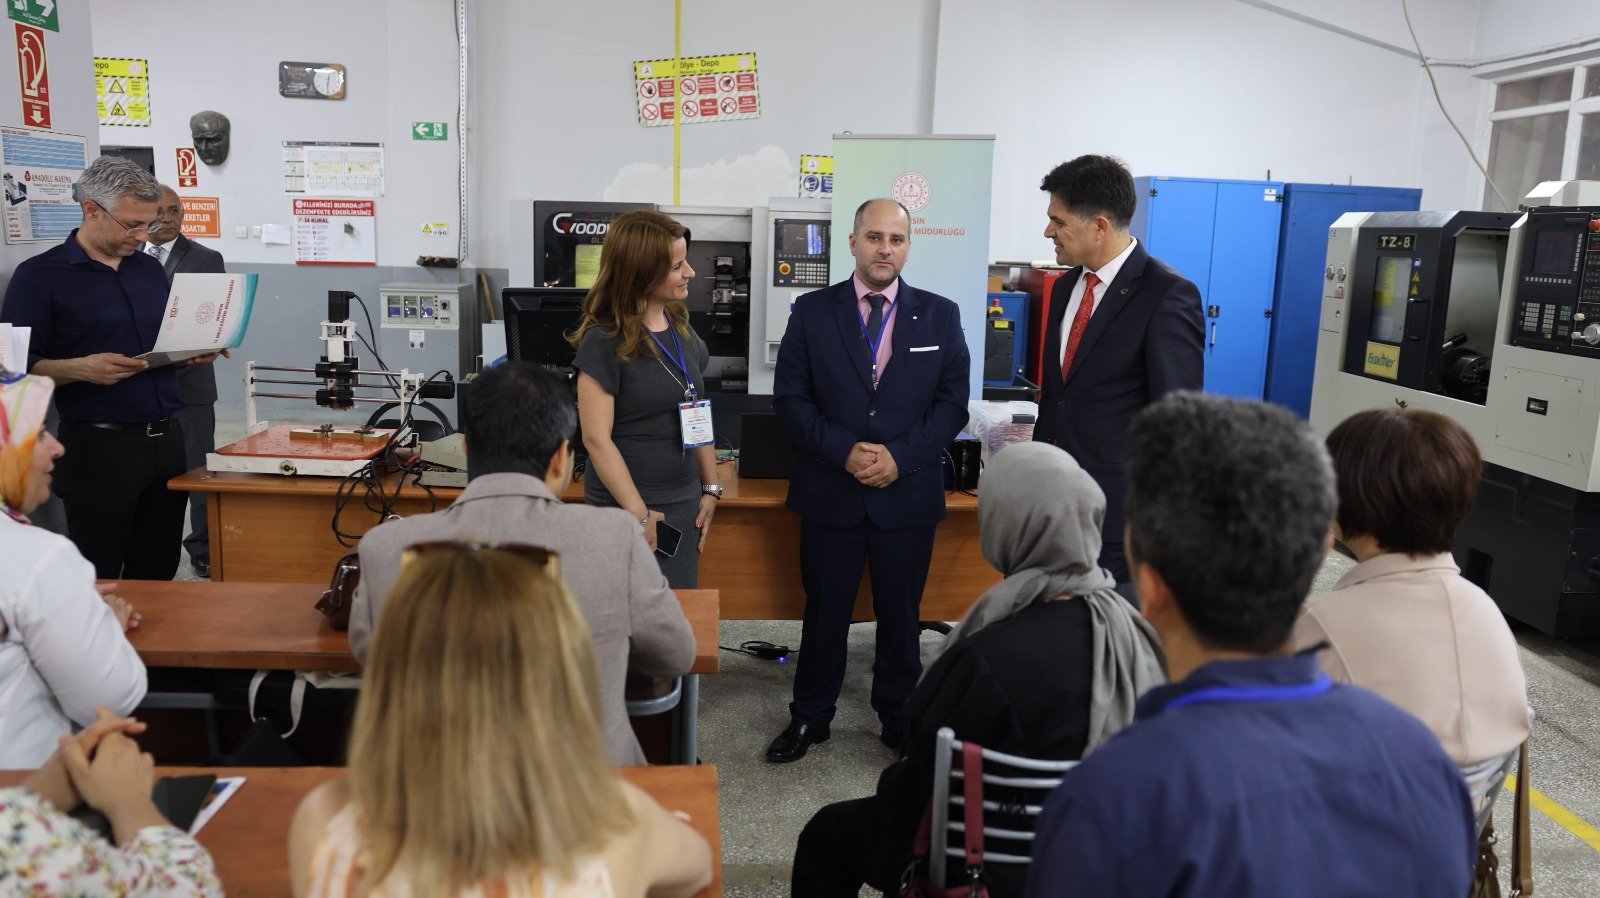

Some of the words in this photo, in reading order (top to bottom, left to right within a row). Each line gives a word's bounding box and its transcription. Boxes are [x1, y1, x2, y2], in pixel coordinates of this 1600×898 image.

[672, 61, 694, 69] ölye
[183, 202, 191, 210] VE
[191, 202, 216, 211] BENZERİ
[180, 224, 207, 233] ASAKTIR
[914, 226, 965, 236] MÜDÜRLÜĞÜ
[1381, 235, 1411, 248] TZ-8
